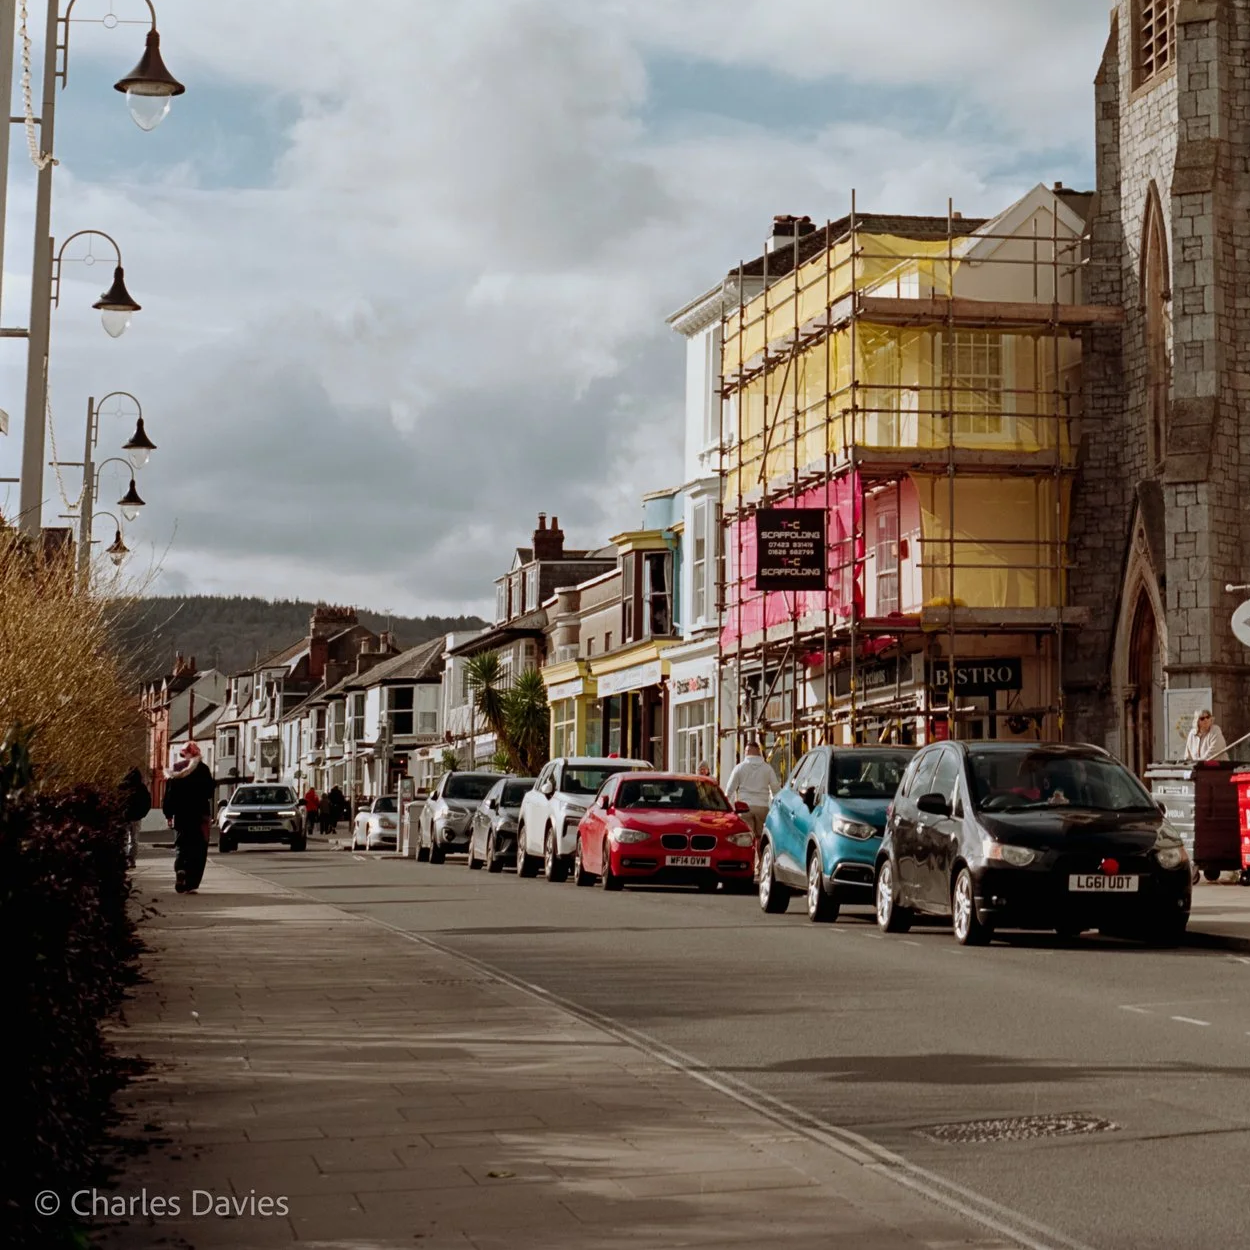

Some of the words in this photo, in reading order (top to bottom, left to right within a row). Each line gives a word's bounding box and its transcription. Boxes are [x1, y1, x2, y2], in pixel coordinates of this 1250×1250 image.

[761, 531, 820, 539] SCAFFOLDING
[761, 568, 821, 576] SCAFFOLDING
[1077, 876, 1105, 889] LG61
[1108, 877, 1132, 889] UDT
